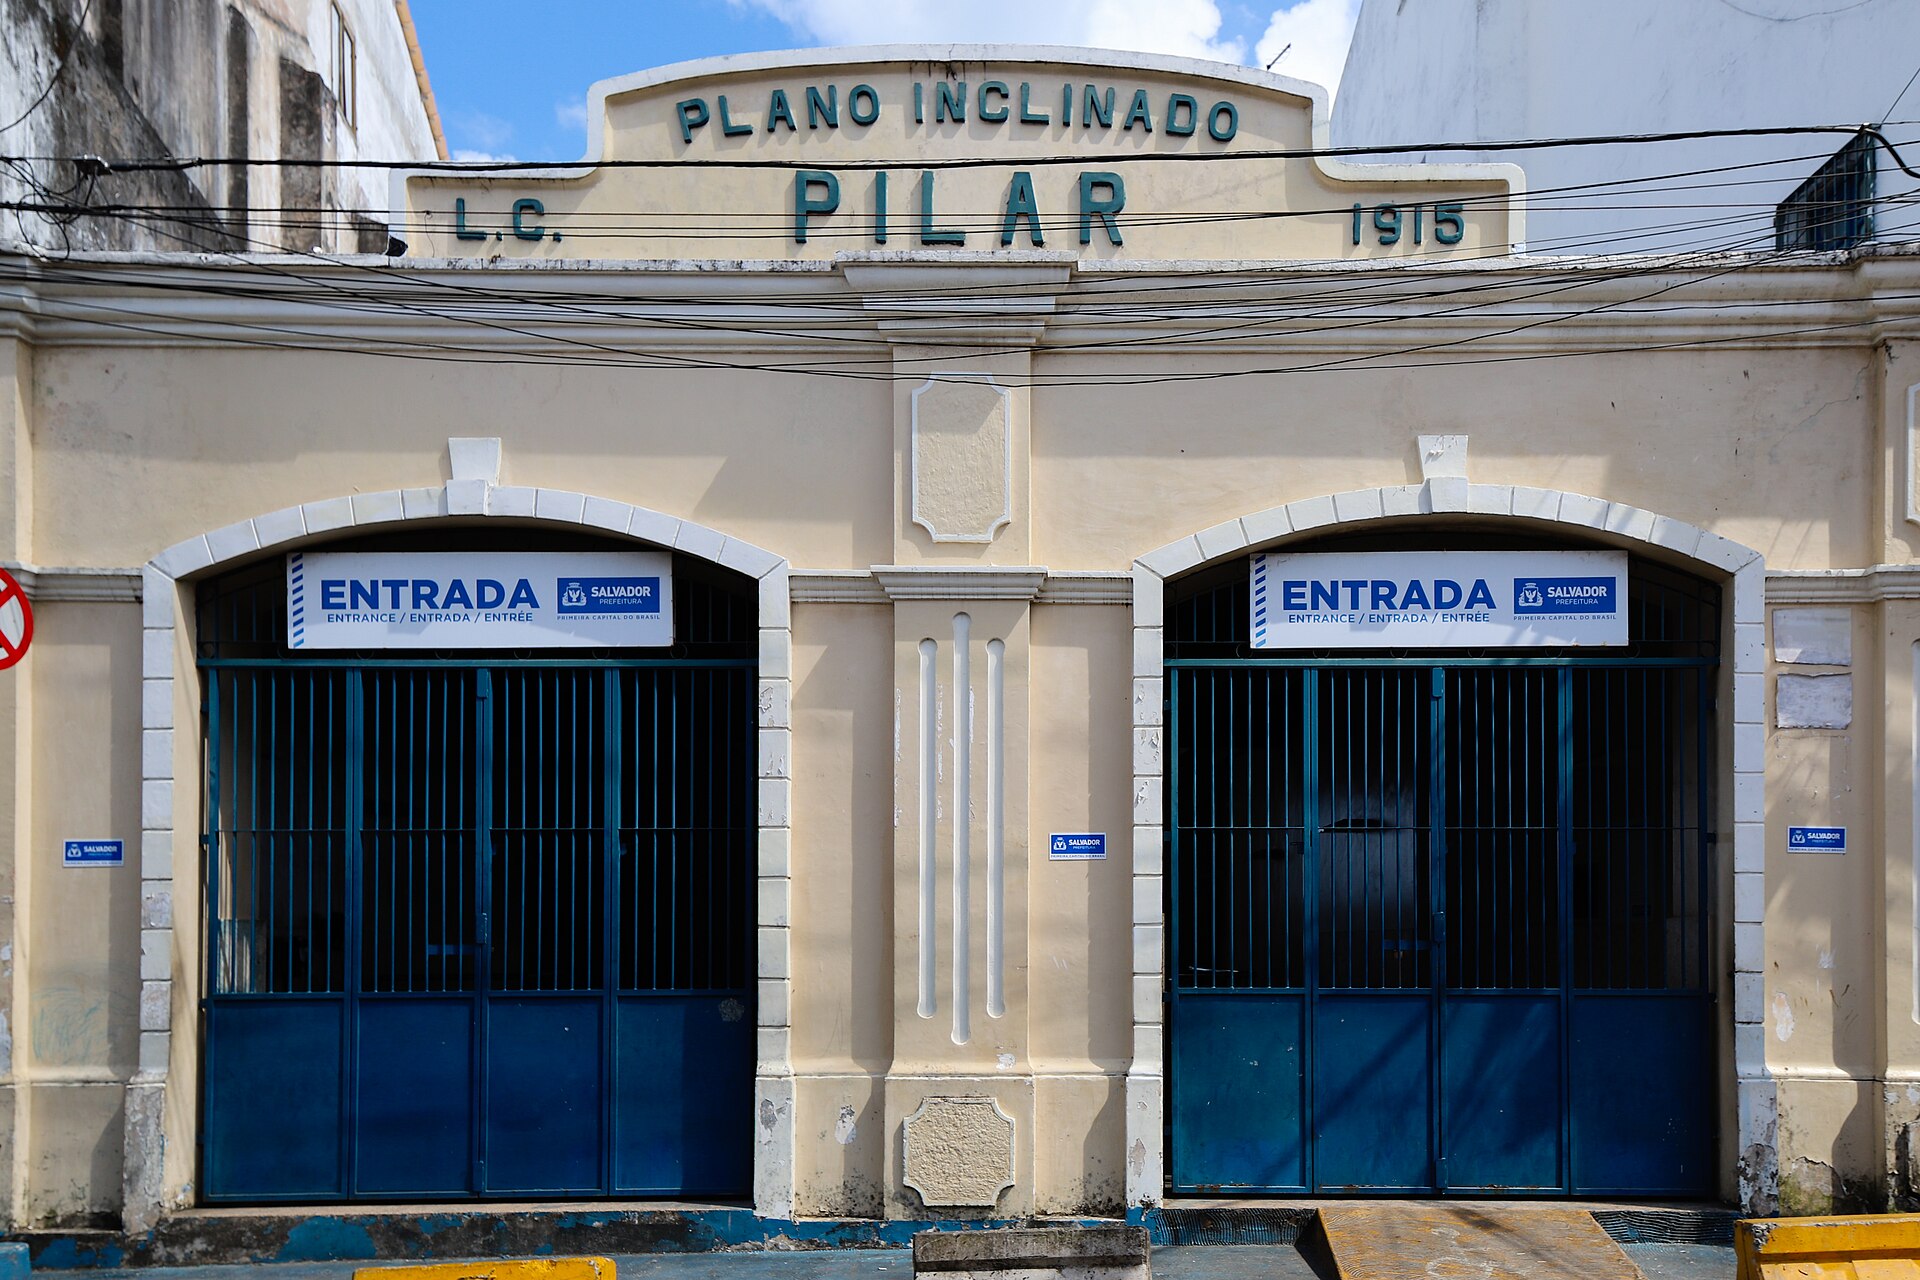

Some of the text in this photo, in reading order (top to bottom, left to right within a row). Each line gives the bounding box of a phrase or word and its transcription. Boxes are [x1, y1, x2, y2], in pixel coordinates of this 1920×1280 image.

[676, 81, 1239, 143] PLANO INCLINADO
[795, 170, 1126, 246] PILAR
[1352, 202, 1465, 245] 1915
[321, 578, 540, 610] ENTRADA
[591, 586, 651, 597] SALVADOR
[1283, 579, 1496, 611] ENTRADA
[1547, 586, 1607, 597] SALVADOR
[327, 613, 396, 623] ENTRANCE
[410, 613, 470, 623] ENTRADA
[484, 611, 533, 622] ENTRÉE
[1288, 613, 1356, 624] ENTRANCE
[1369, 613, 1428, 624] ENTRADA
[1442, 611, 1490, 623] ENTRÉE
